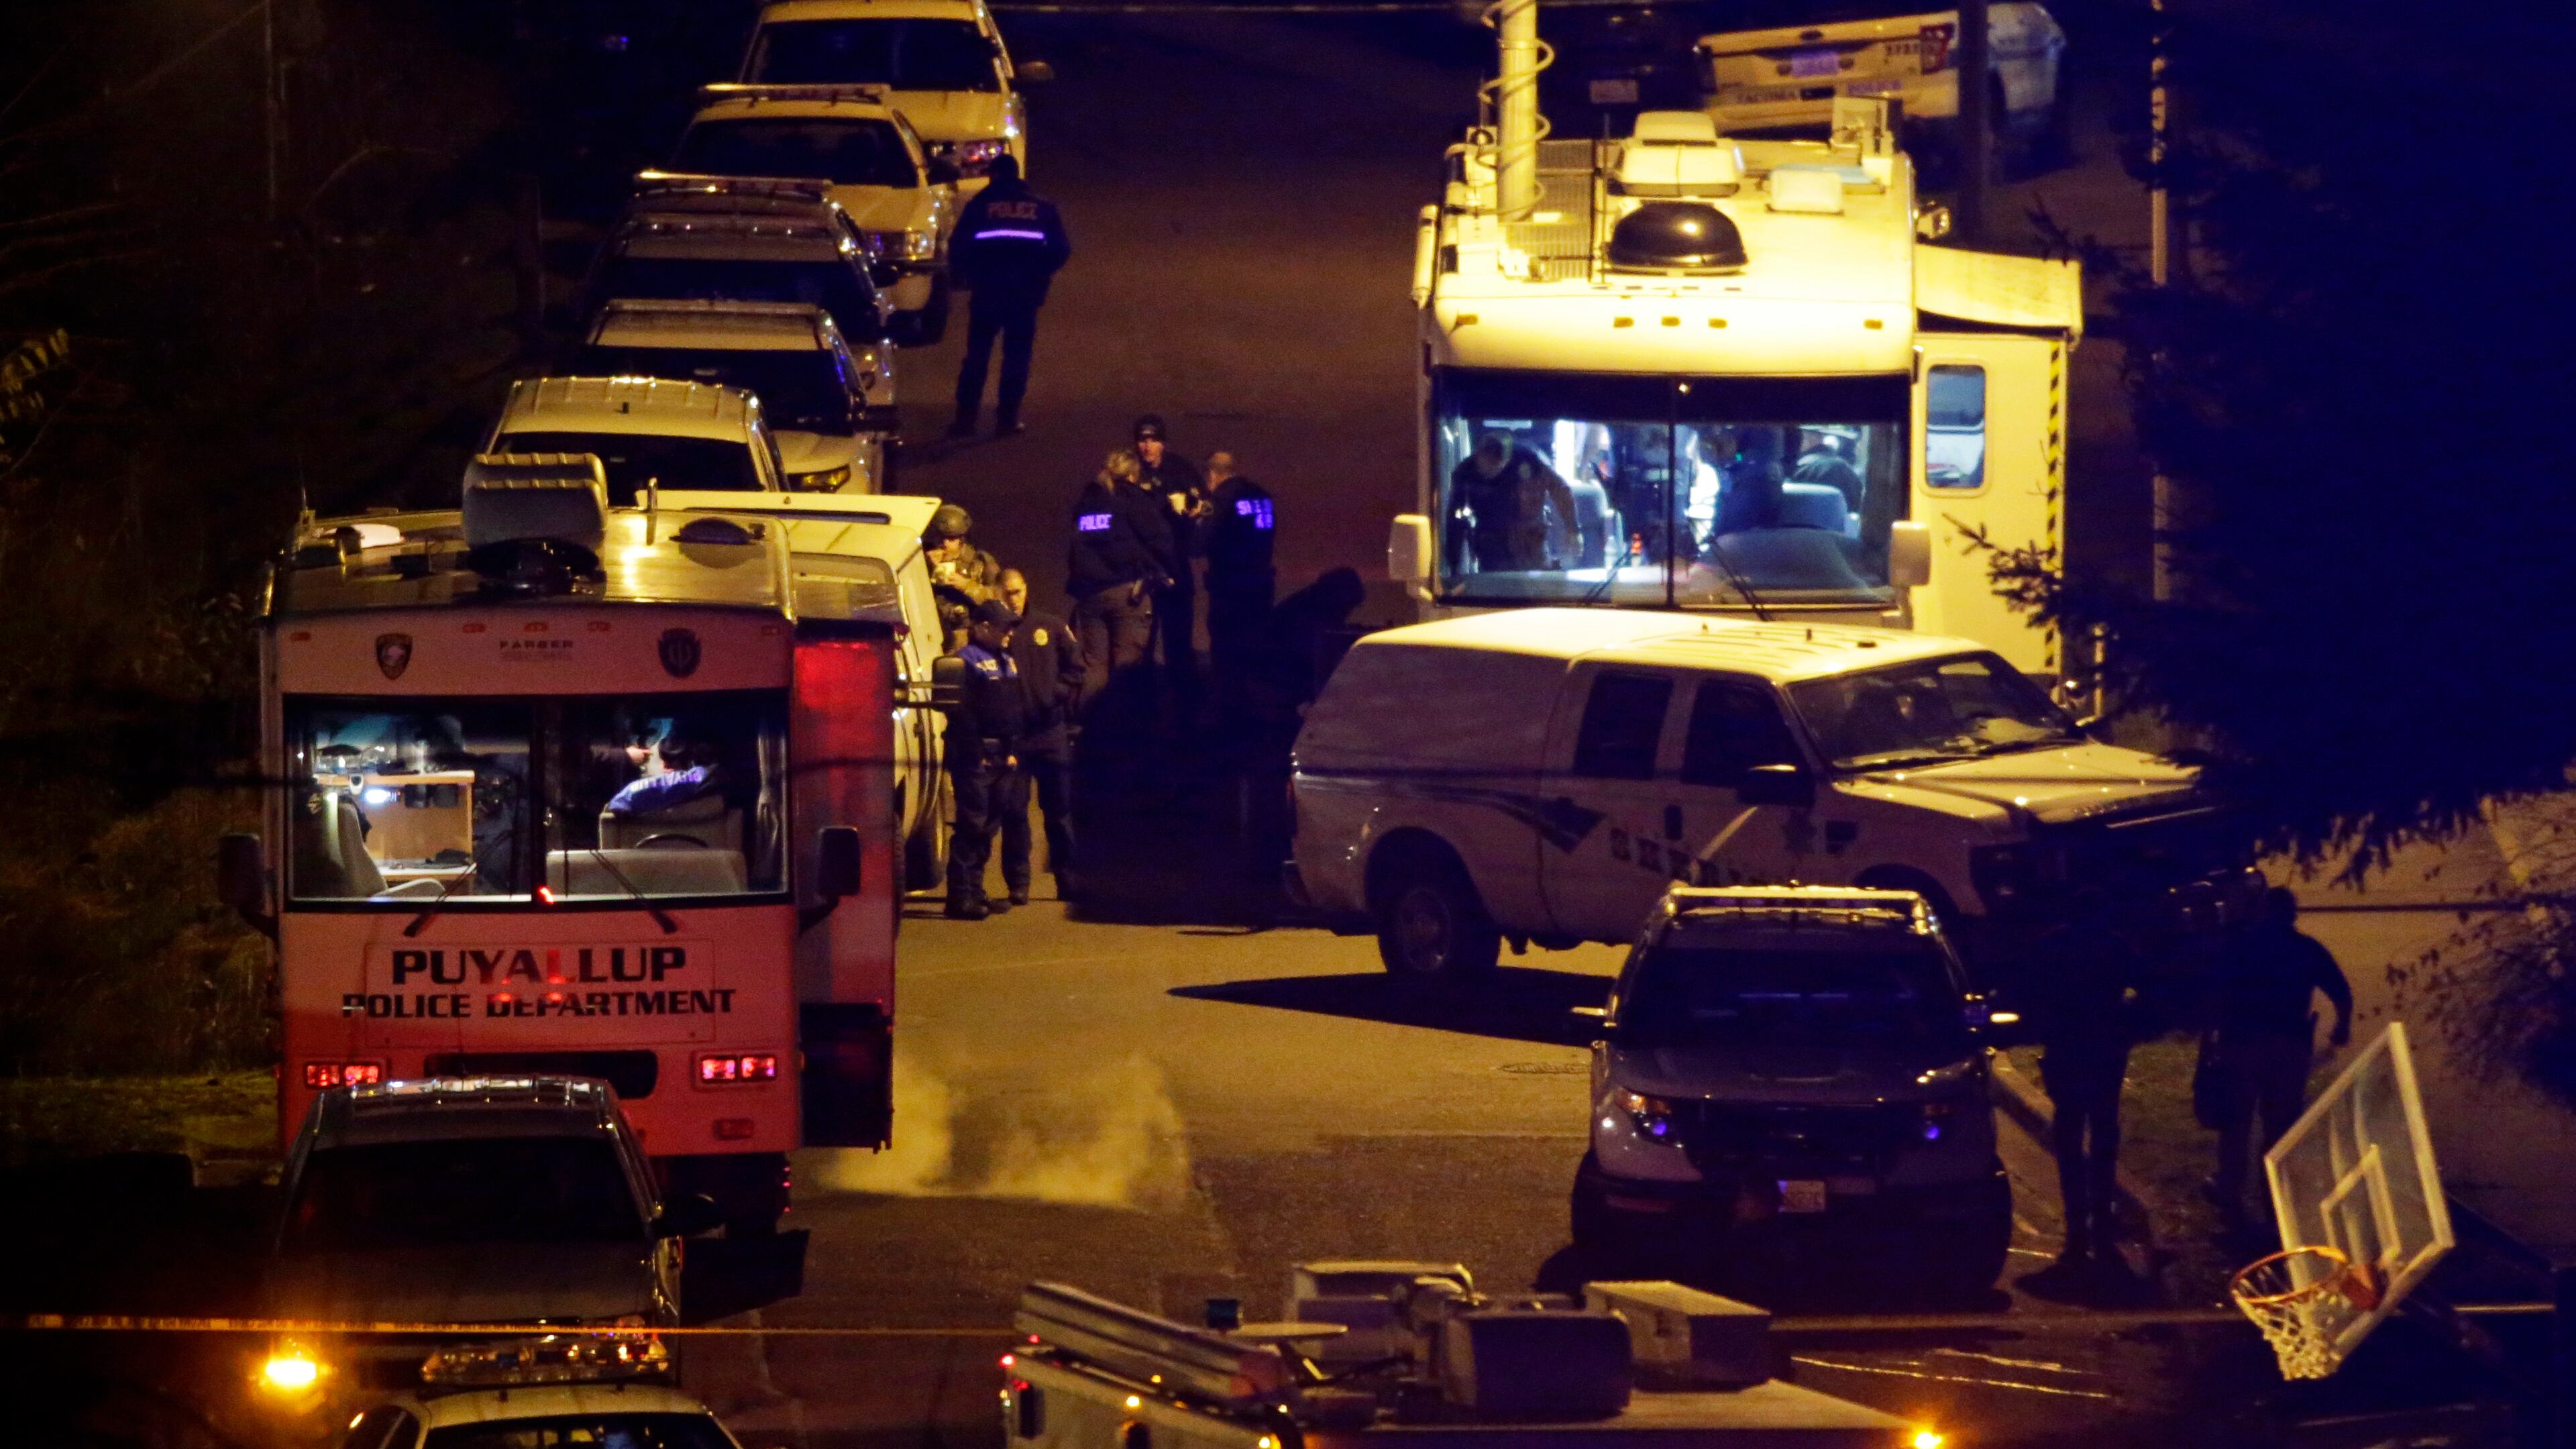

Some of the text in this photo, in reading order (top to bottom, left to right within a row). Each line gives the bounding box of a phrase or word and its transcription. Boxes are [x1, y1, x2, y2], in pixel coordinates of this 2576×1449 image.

[987, 201, 1038, 221] POLICE
[1079, 514, 1114, 531] POLICE
[1610, 827, 1767, 886] SHER
[391, 947, 686, 985] PUYALLUP
[341, 987, 737, 1019] POLICE DEPARTMENT
